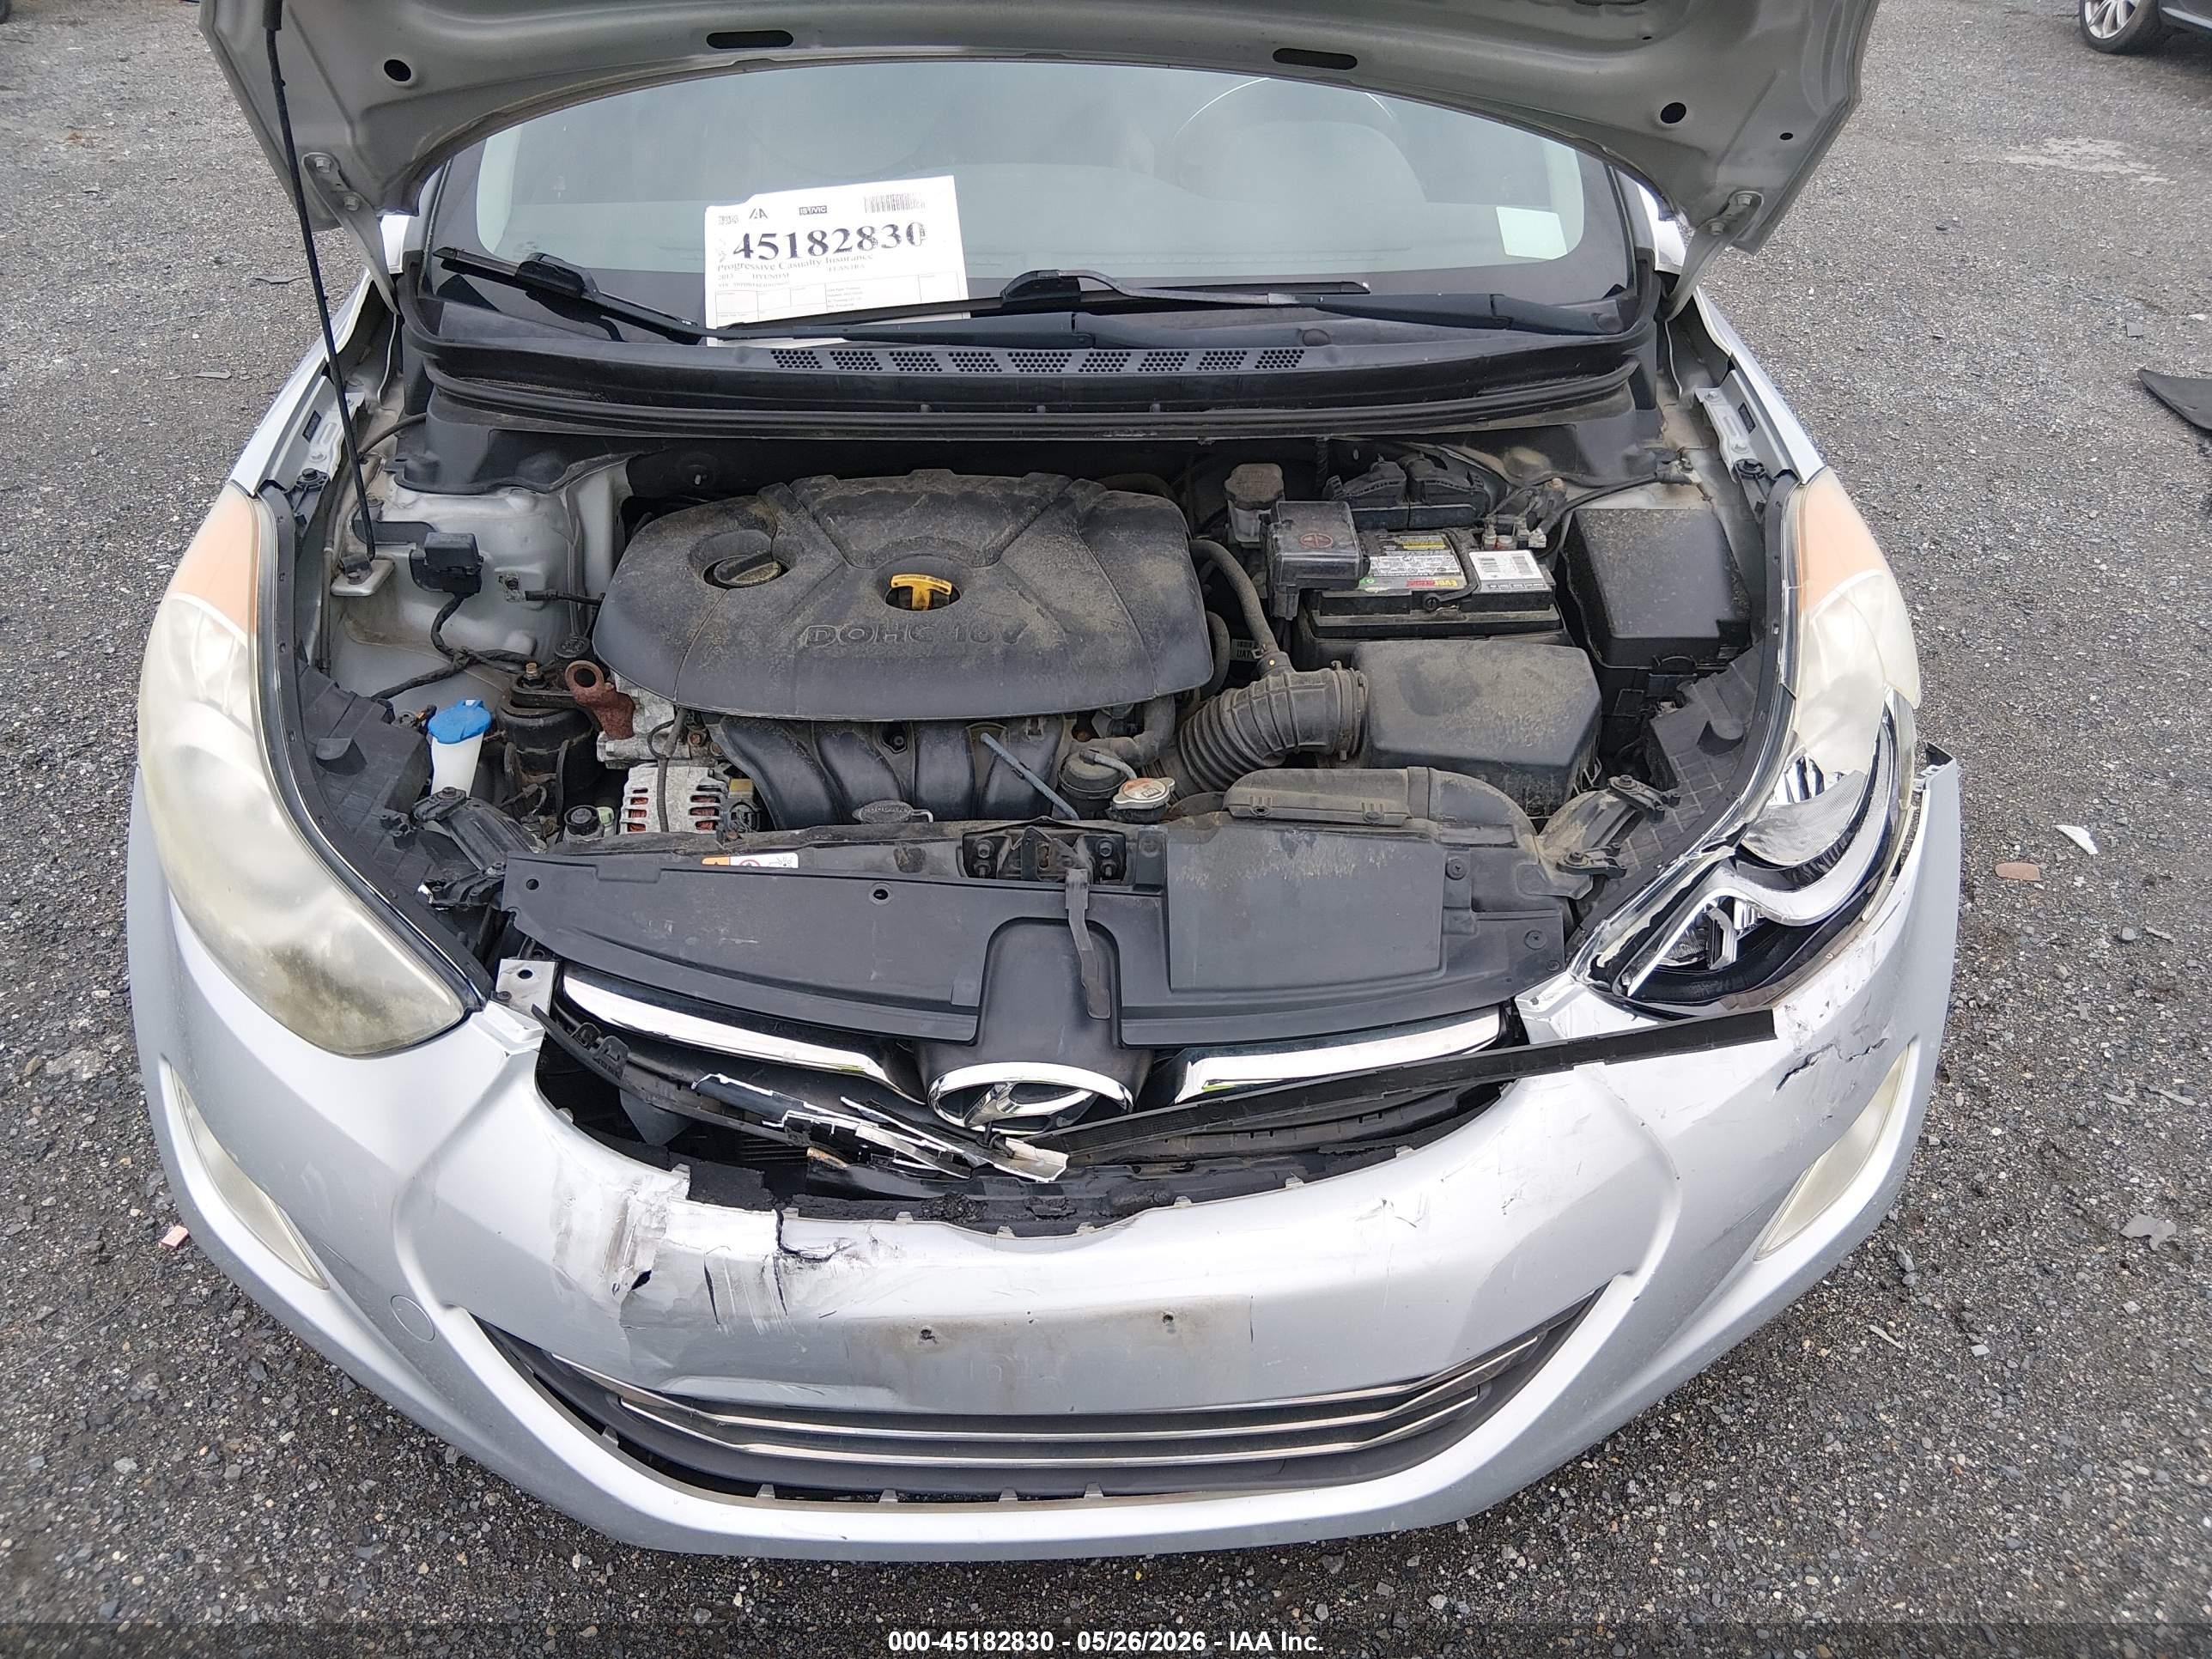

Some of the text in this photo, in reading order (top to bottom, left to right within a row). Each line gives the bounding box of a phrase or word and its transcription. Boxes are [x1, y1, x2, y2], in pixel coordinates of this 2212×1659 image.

[732, 222, 926, 260] 45182830
[717, 252, 873, 272] Progressive Casualty Insurance
[799, 624, 935, 645] DOHC
